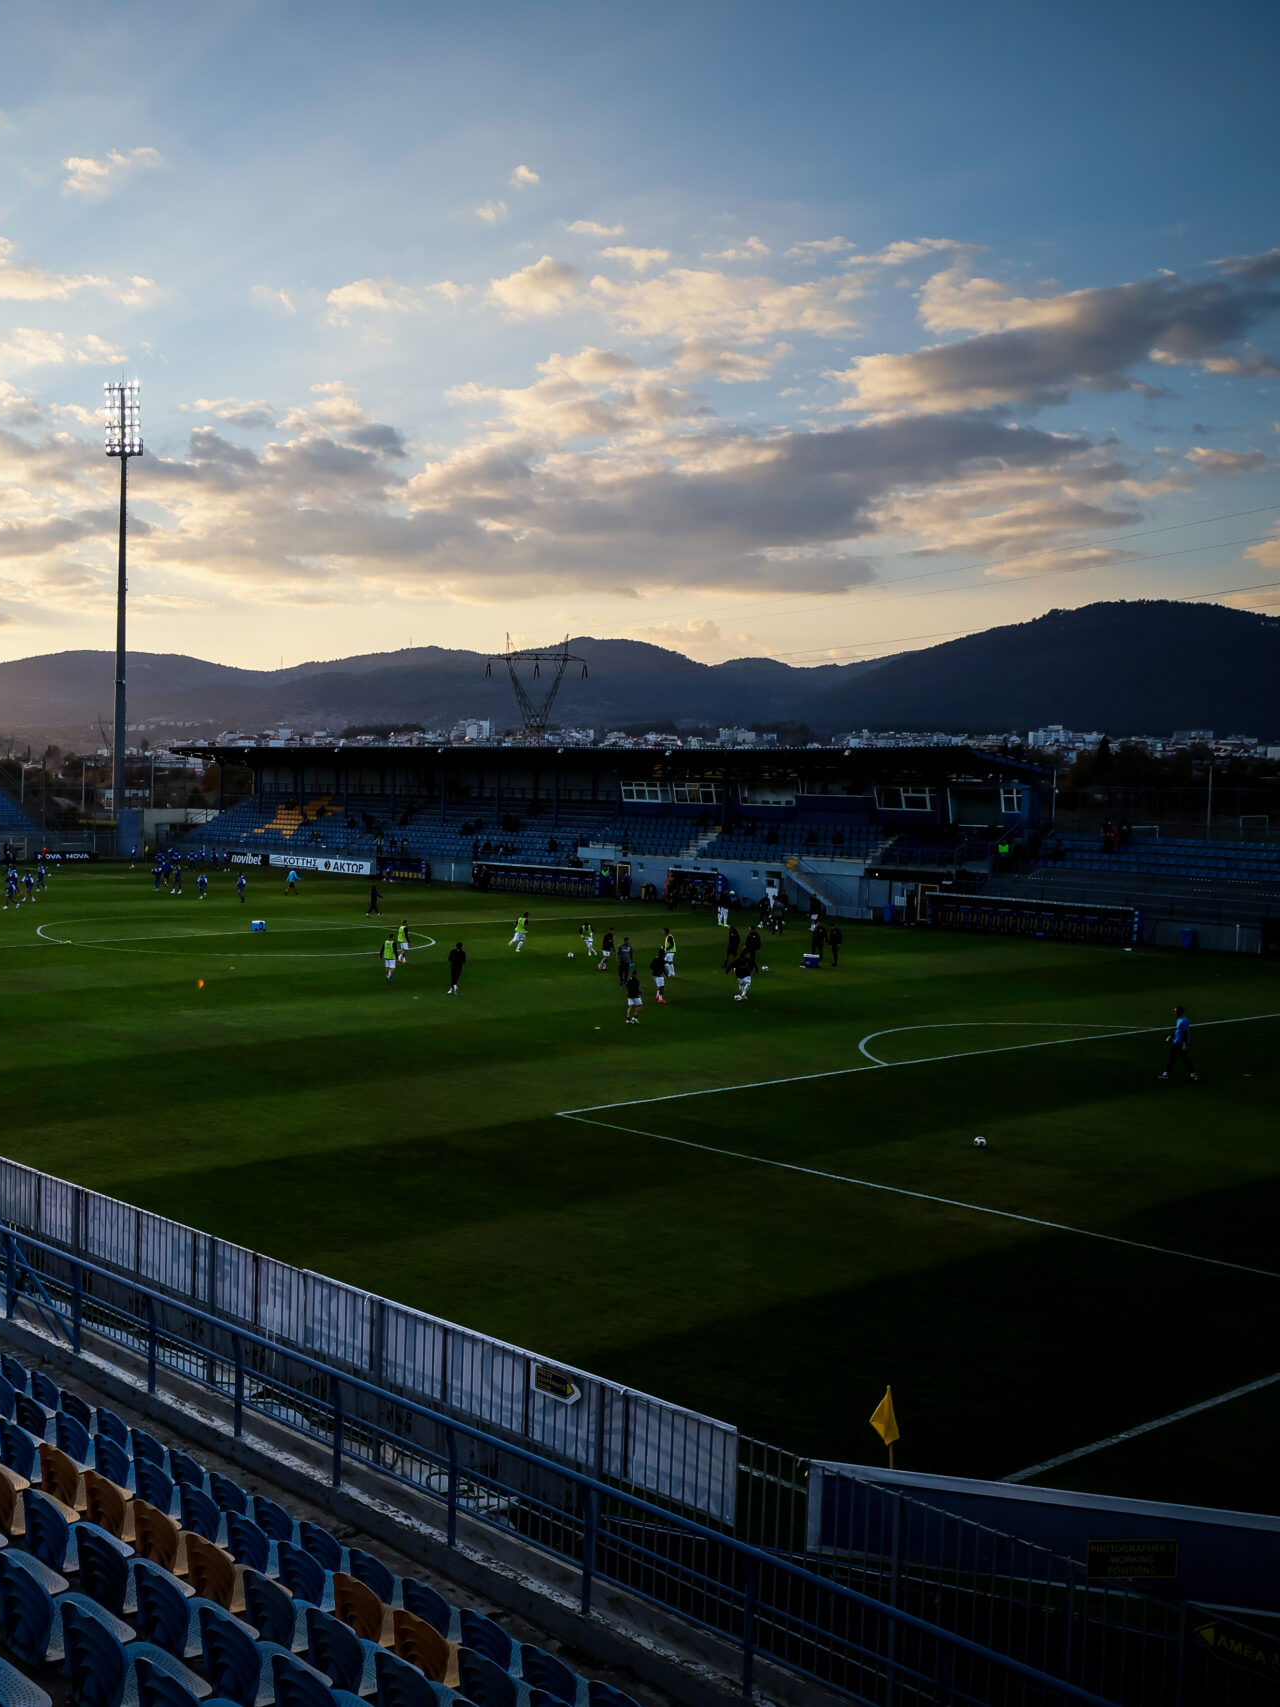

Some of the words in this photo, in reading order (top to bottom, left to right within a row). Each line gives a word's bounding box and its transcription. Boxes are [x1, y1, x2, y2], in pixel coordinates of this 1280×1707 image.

[231, 852, 263, 865] novibet
[283, 856, 318, 867] ΚΟΤΤΗΣ
[1110, 1555, 1154, 1564] WORKING
[1107, 1566, 1156, 1575] POSITIONS
